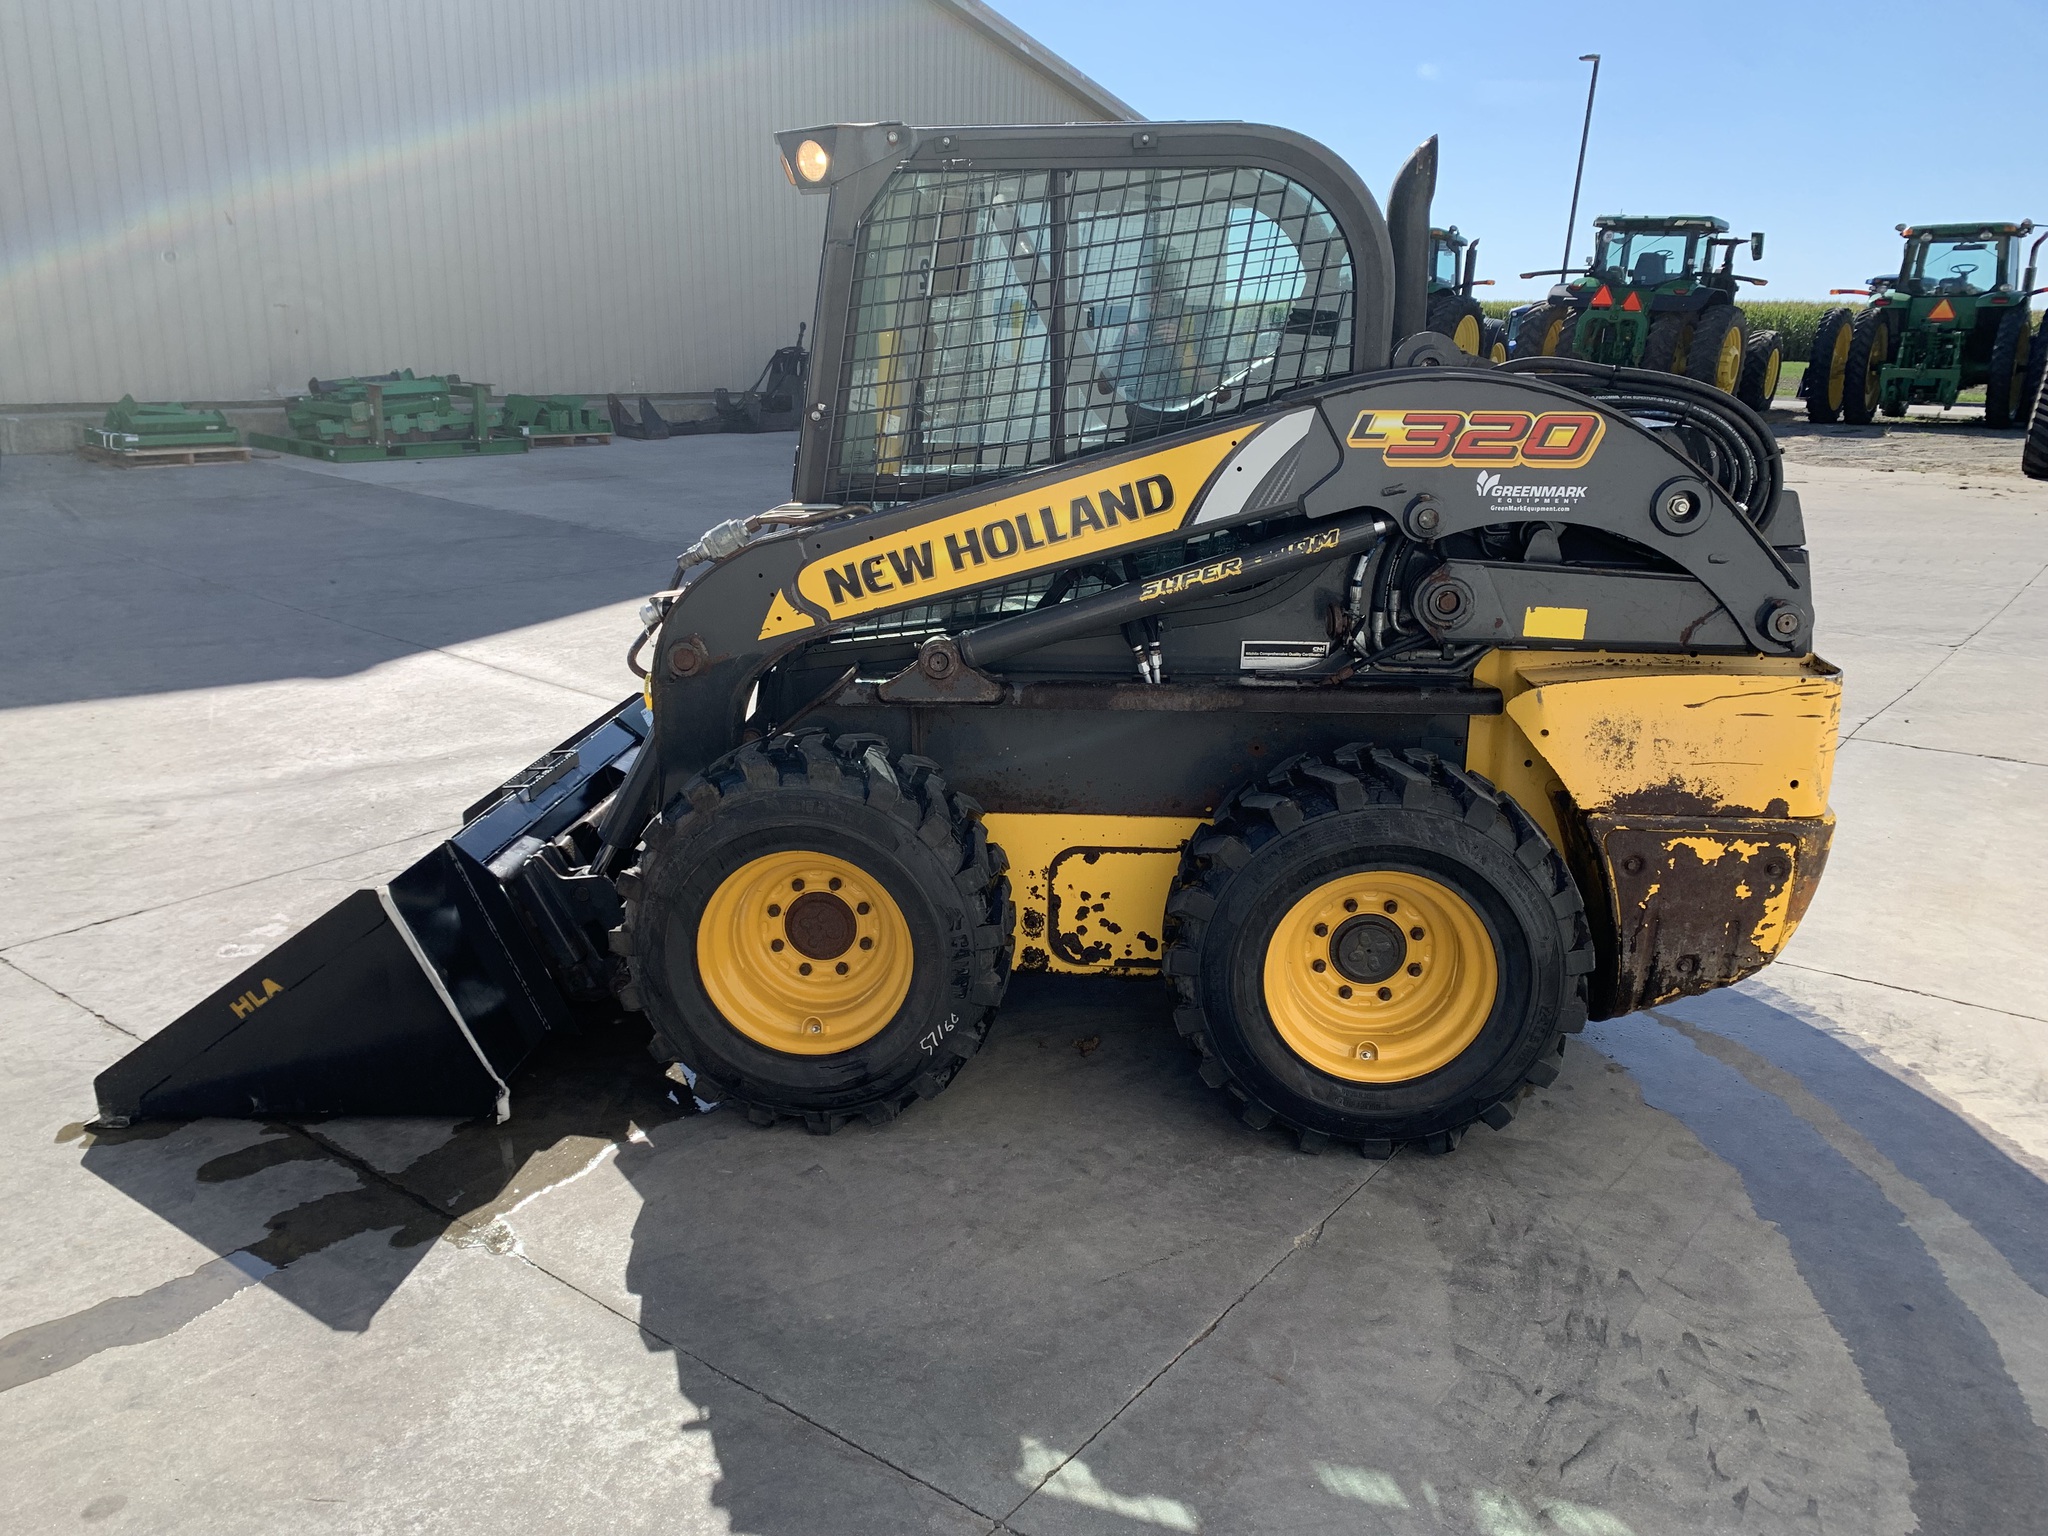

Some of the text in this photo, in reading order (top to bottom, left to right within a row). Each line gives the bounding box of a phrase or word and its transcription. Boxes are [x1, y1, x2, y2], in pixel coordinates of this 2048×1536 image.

[1490, 505, 1570, 513] GreenMarkEquipment.com
[1491, 485, 1588, 498] GREENMARK
[824, 474, 1175, 604] NEW HOLLAND
[1139, 557, 1243, 602] SUPER
[229, 977, 284, 1019] HLA
